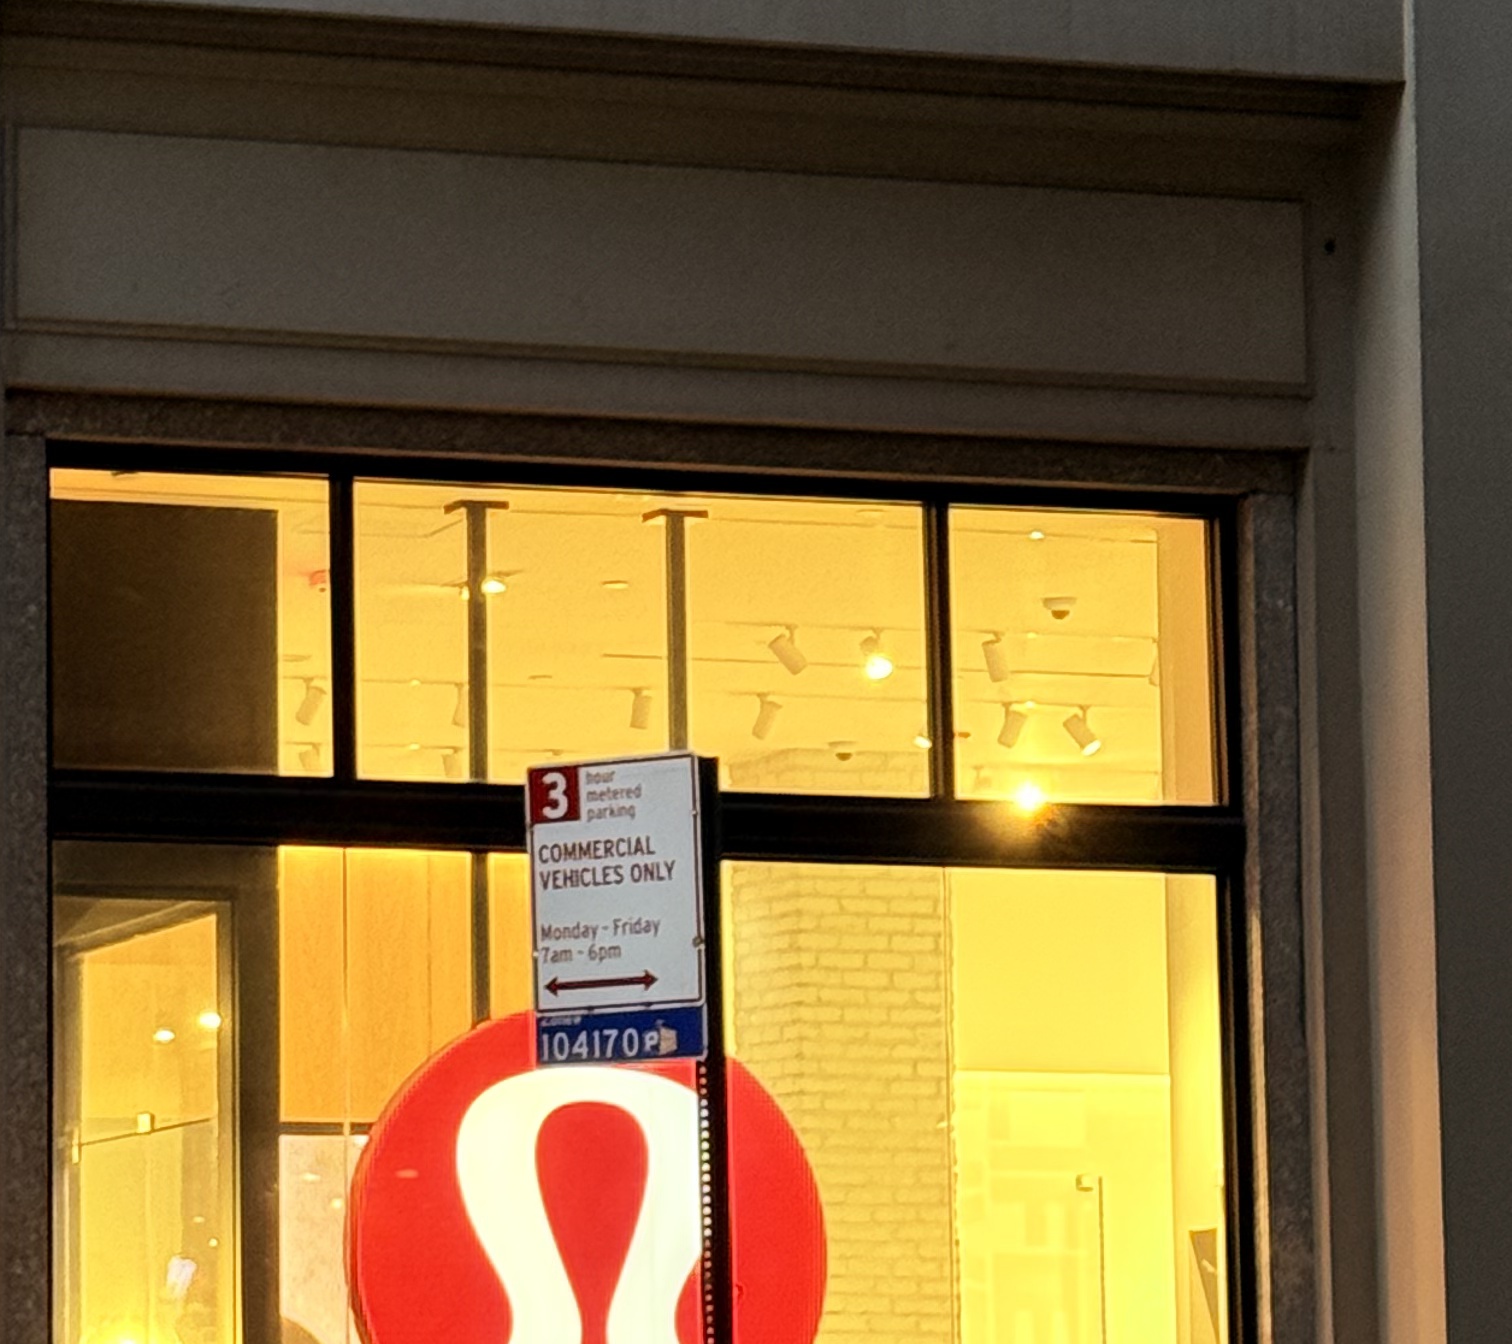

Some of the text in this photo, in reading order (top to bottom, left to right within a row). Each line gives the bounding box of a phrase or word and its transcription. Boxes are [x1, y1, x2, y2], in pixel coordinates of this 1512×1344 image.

[586, 770, 615, 785] hour
[542, 772, 568, 819] 3
[586, 783, 642, 802] metered
[587, 804, 636, 822] parking
[538, 835, 656, 864] COMMERCIAL
[539, 859, 676, 891] VEHICLES ONLY
[541, 921, 599, 942] Monday
[613, 916, 661, 937] Friday
[541, 946, 573, 964] 7am
[588, 943, 622, 963] 6pm
[542, 1027, 639, 1061] 104170
